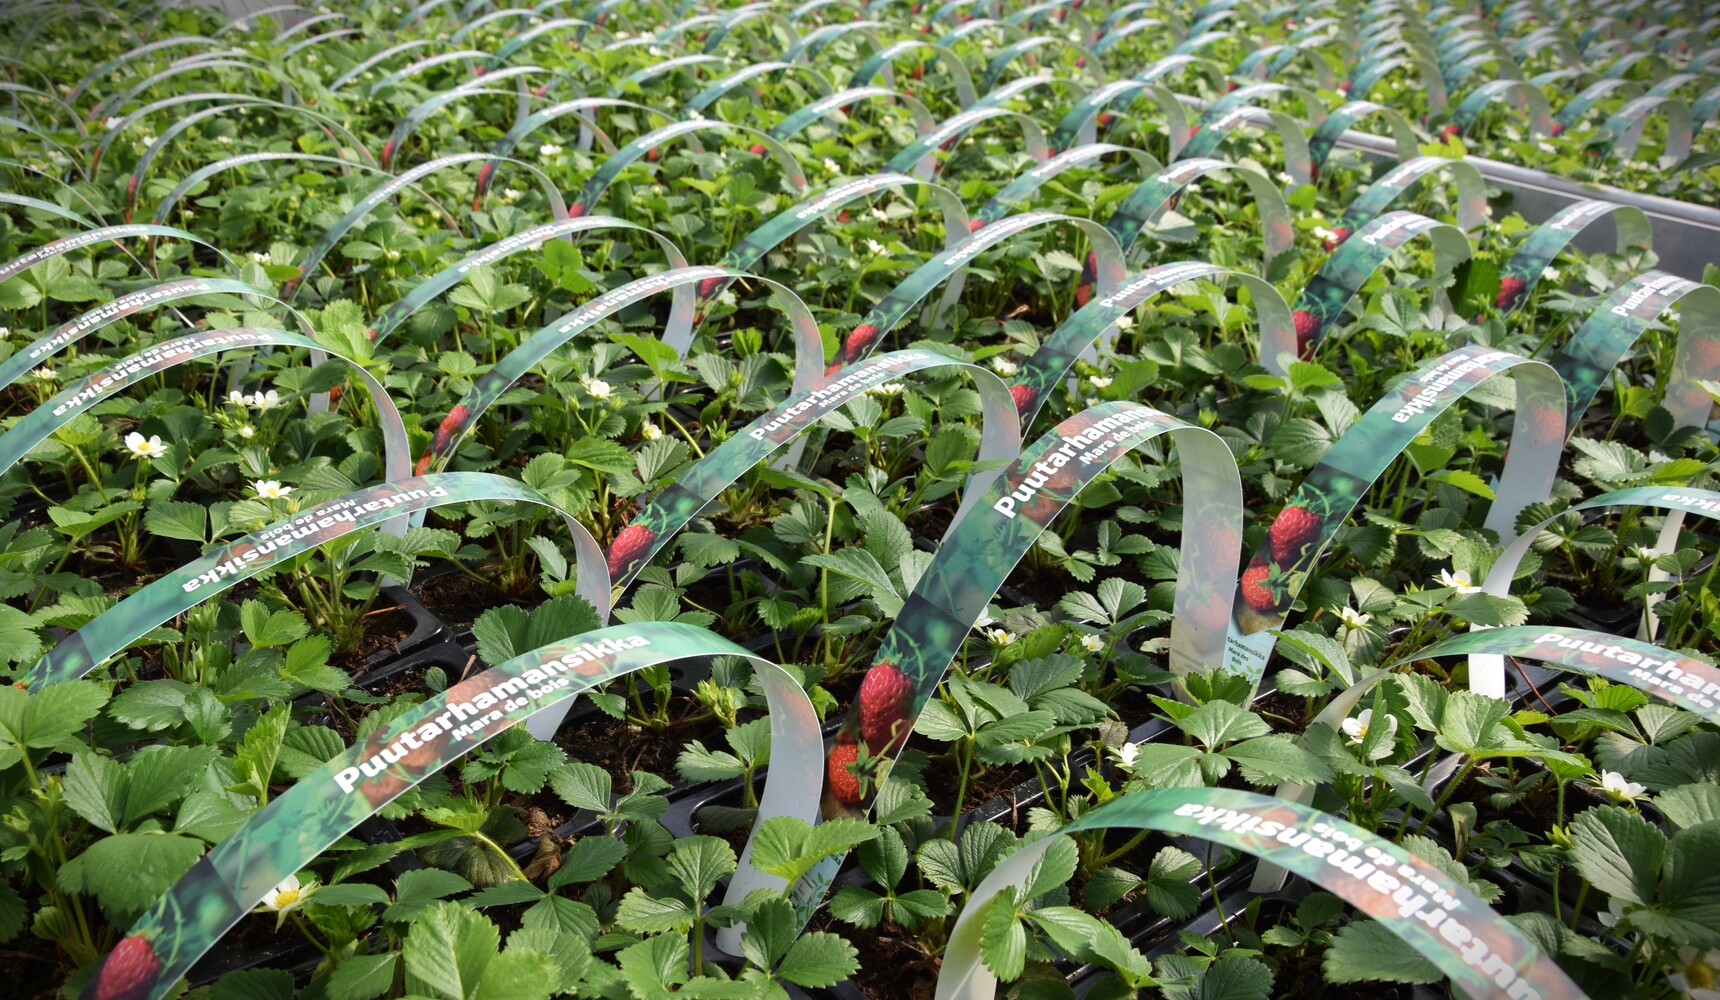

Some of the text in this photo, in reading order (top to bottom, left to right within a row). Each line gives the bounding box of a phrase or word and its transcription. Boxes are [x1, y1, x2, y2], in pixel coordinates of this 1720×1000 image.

[0, 226, 149, 275] uutarhamansikka
[52, 333, 274, 417] Puutarhamansikka
[115, 337, 197, 370] Mara de bois
[749, 352, 930, 441] Puutarhamansikka
[818, 389, 849, 408] Mara
[848, 380, 863, 392] de
[1078, 419, 1156, 465] Mara de bois
[182, 485, 449, 593] Puutarhamansikka
[260, 498, 356, 541] Mara de bois
[1227, 636, 1266, 661] tarhamansikka
[333, 634, 651, 794] Puutarhamansikka
[452, 675, 571, 742] Mara de bois
[1627, 667, 1715, 709] Mara de
[1312, 822, 1463, 912] Mara de bois
[1174, 802, 1542, 1000] uutarhamansikka
